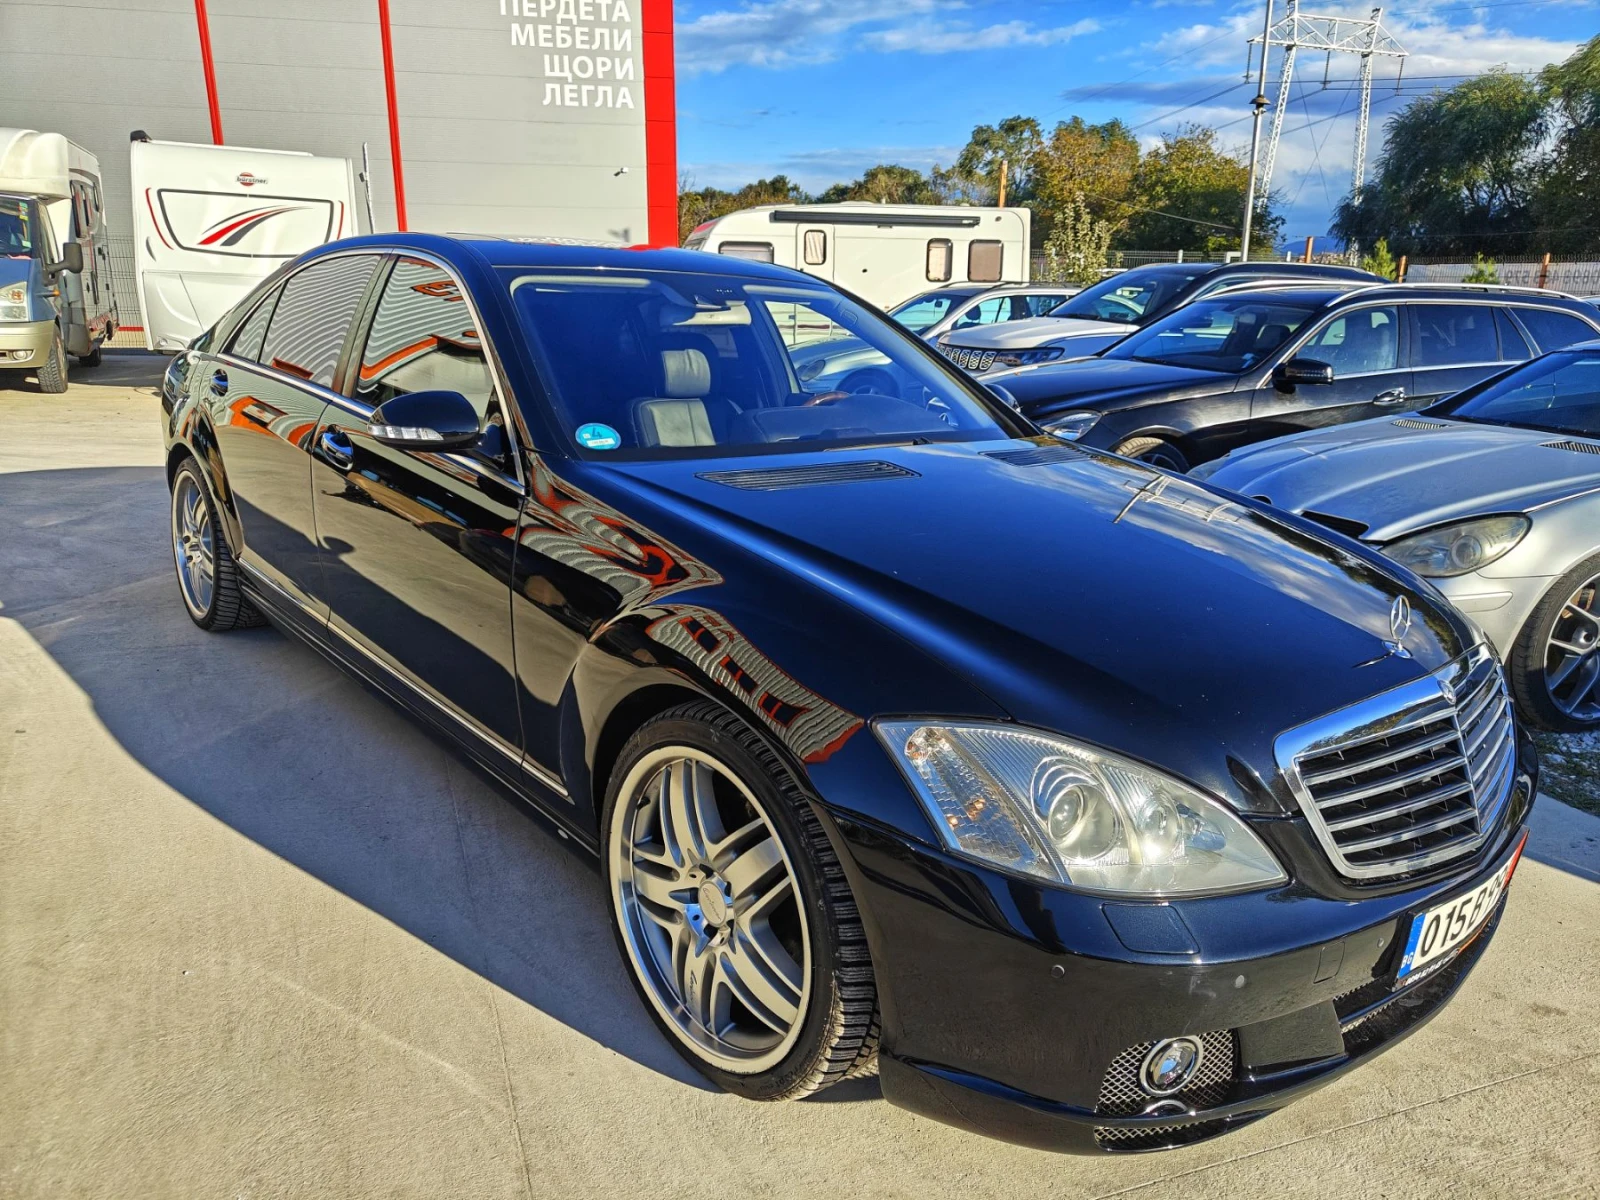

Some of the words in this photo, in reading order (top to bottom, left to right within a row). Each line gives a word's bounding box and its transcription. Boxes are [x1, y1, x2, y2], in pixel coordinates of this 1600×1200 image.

[500, 0, 631, 25] ПЕРДЕТА
[511, 23, 632, 52] МЕБЕЛИ
[544, 54, 634, 83] ЩОРИ
[542, 83, 635, 109] ЛЕГЛА
